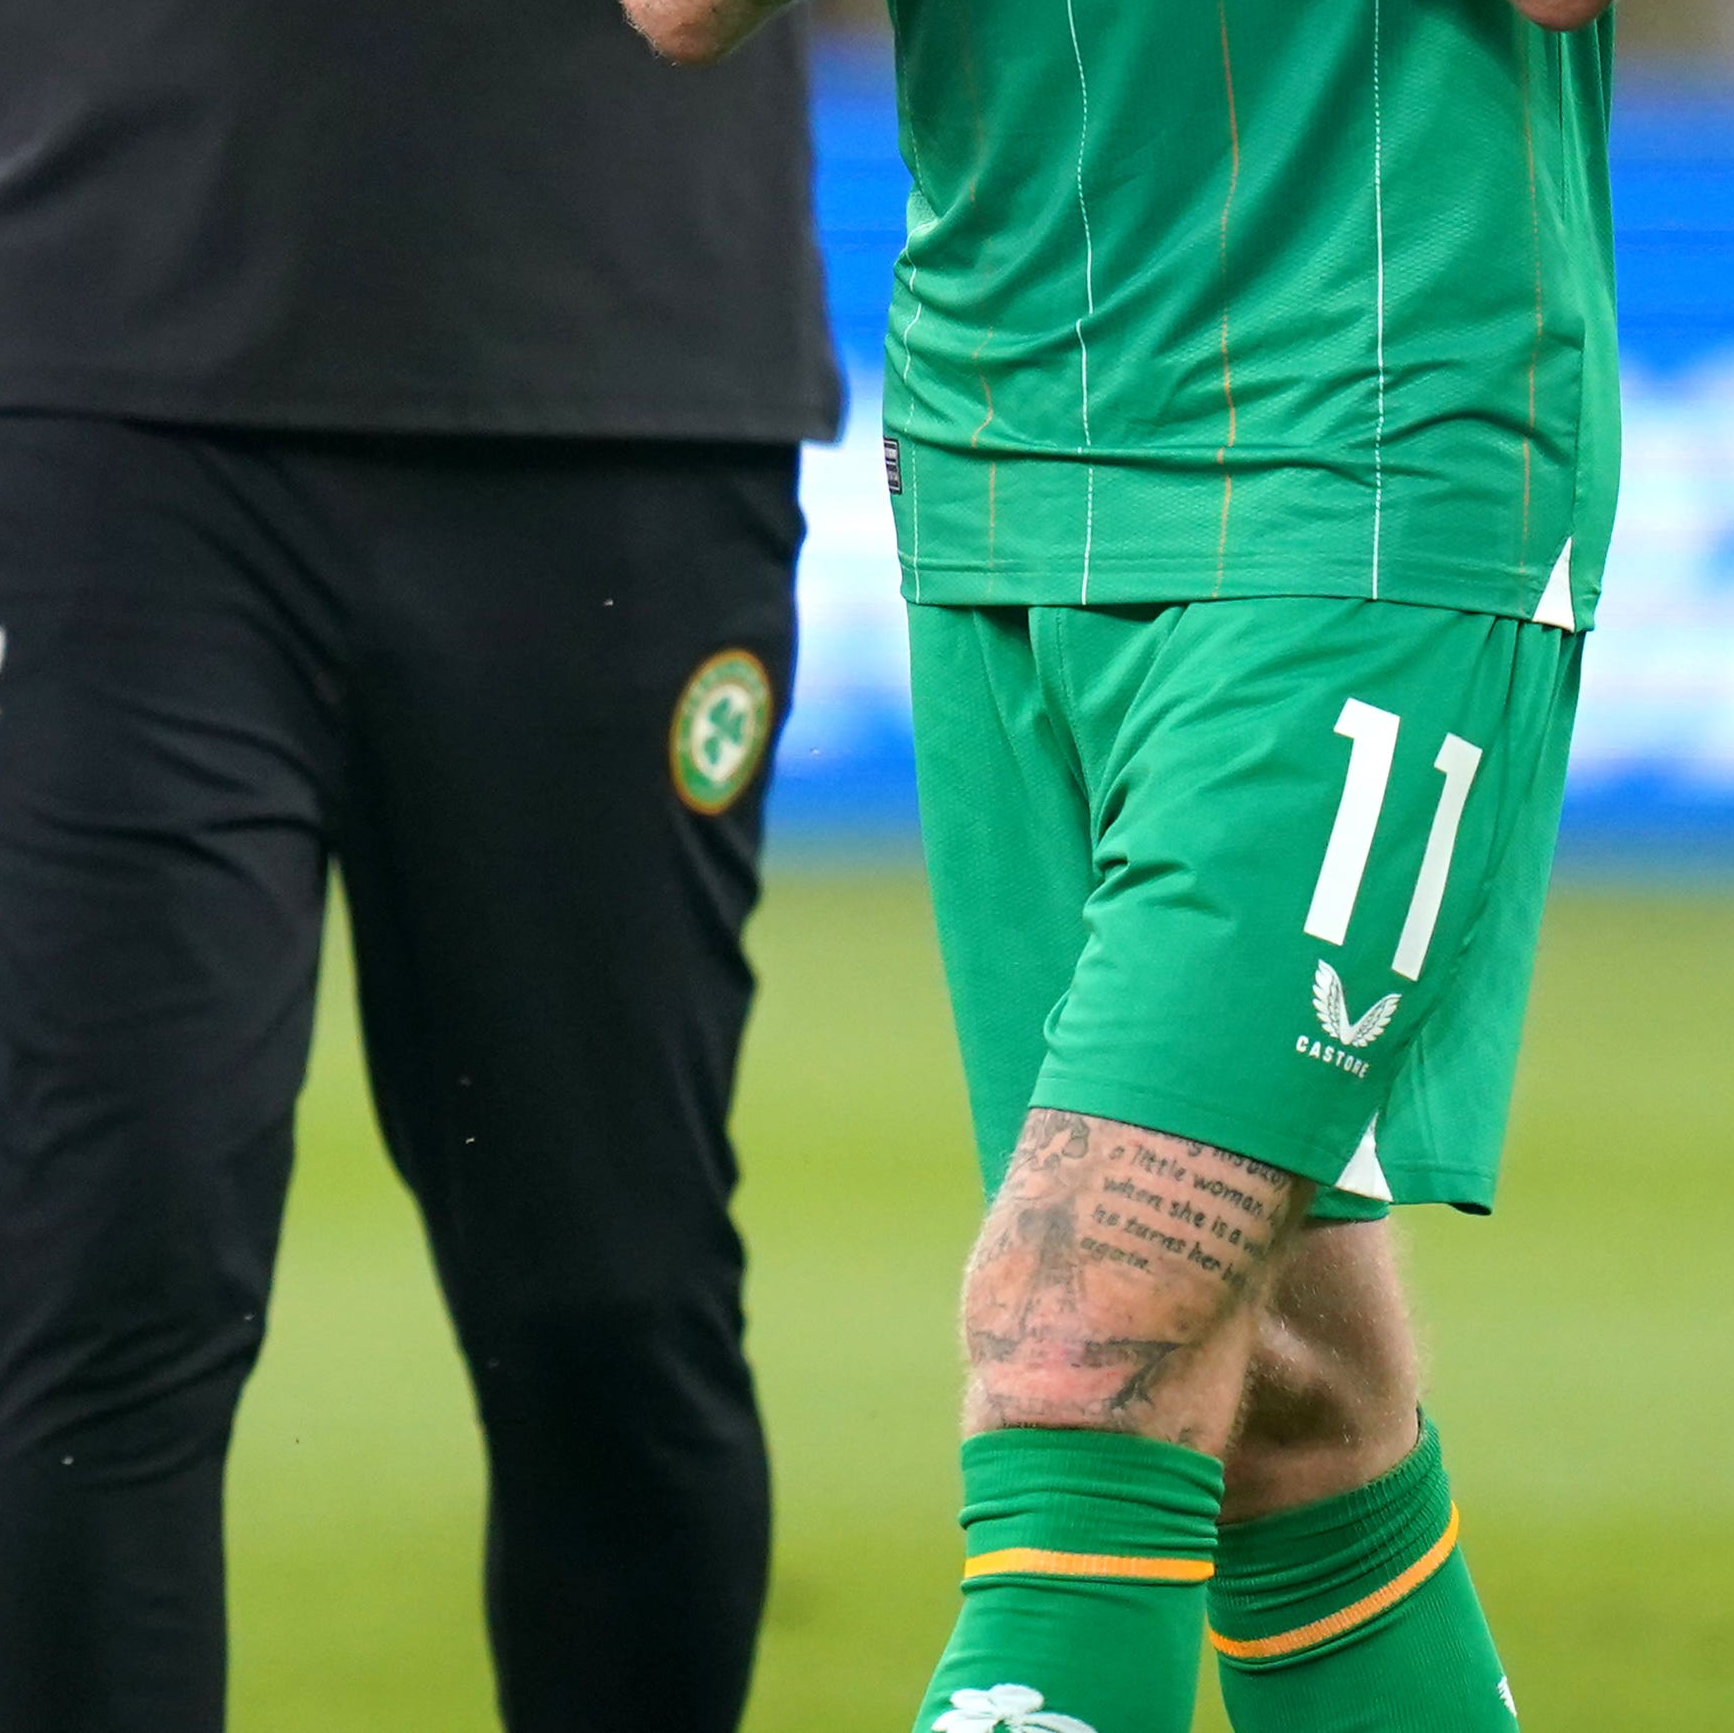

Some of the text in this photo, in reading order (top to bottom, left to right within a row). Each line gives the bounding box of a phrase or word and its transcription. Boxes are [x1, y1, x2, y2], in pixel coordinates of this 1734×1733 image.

[1303, 697, 1483, 981] 11
[1296, 1035, 1369, 1078] CASTORE
[1169, 1200, 1205, 1228] she
[1193, 1173, 1263, 1217] woman
